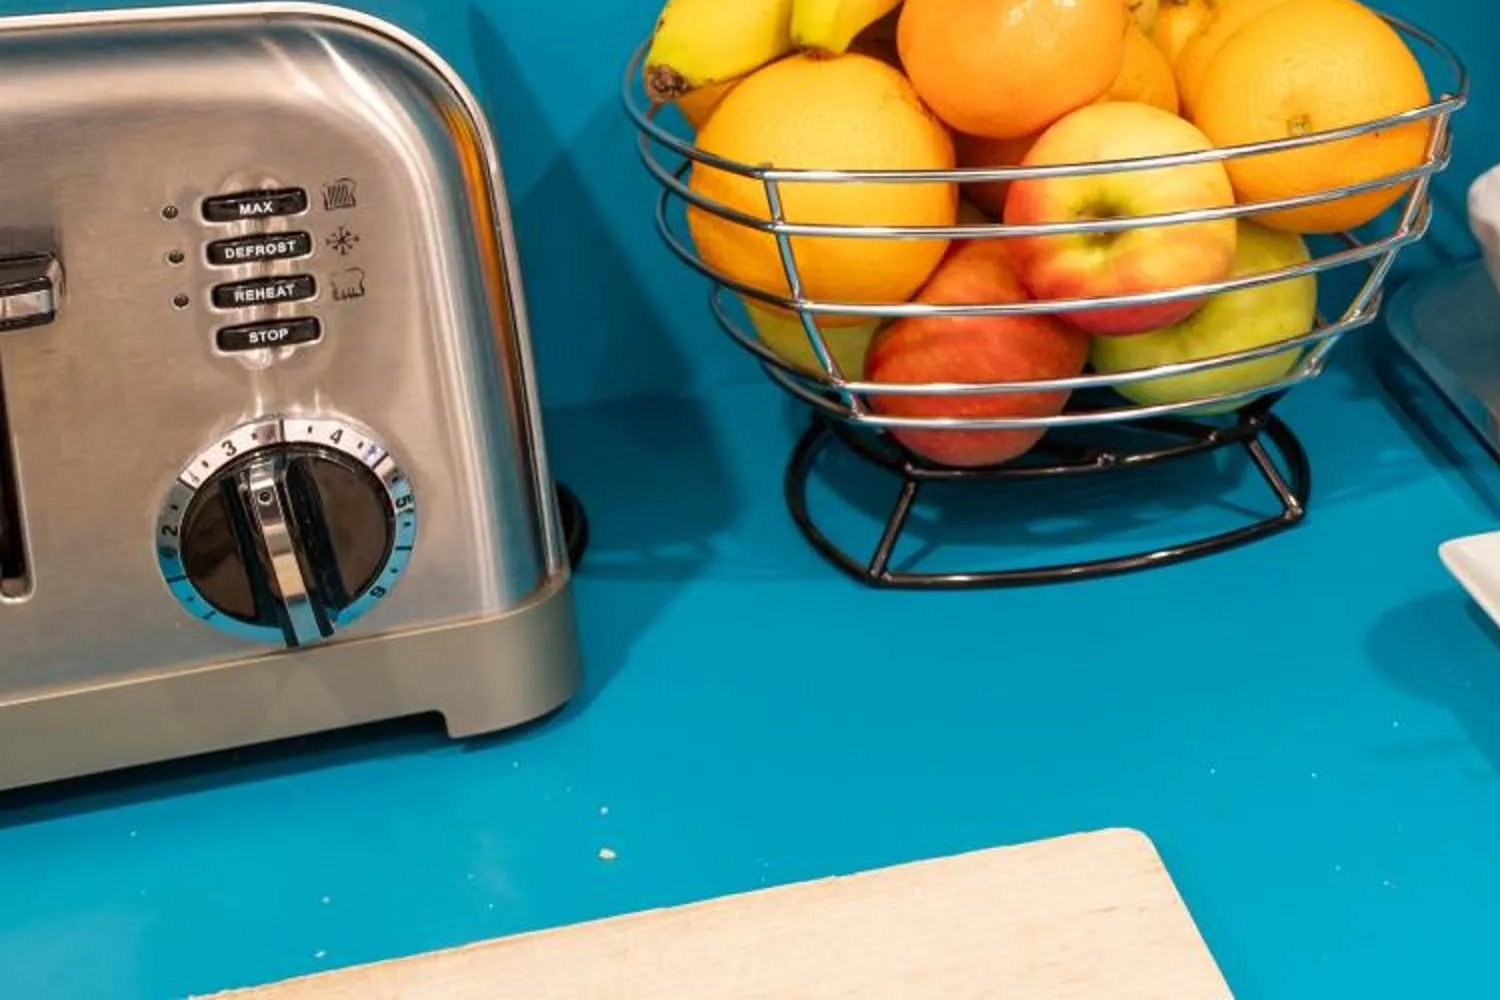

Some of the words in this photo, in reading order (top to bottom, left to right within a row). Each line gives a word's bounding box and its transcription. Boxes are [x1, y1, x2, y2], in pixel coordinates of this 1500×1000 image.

[239, 201, 273, 215] MAX
[225, 241, 296, 259] DEFROST
[235, 285, 295, 301] REHEAT
[249, 329, 289, 344] STOP
[329, 429, 343, 445] 4
[221, 439, 237, 456] 3
[395, 494, 412, 508] 5
[161, 525, 178, 536] 2
